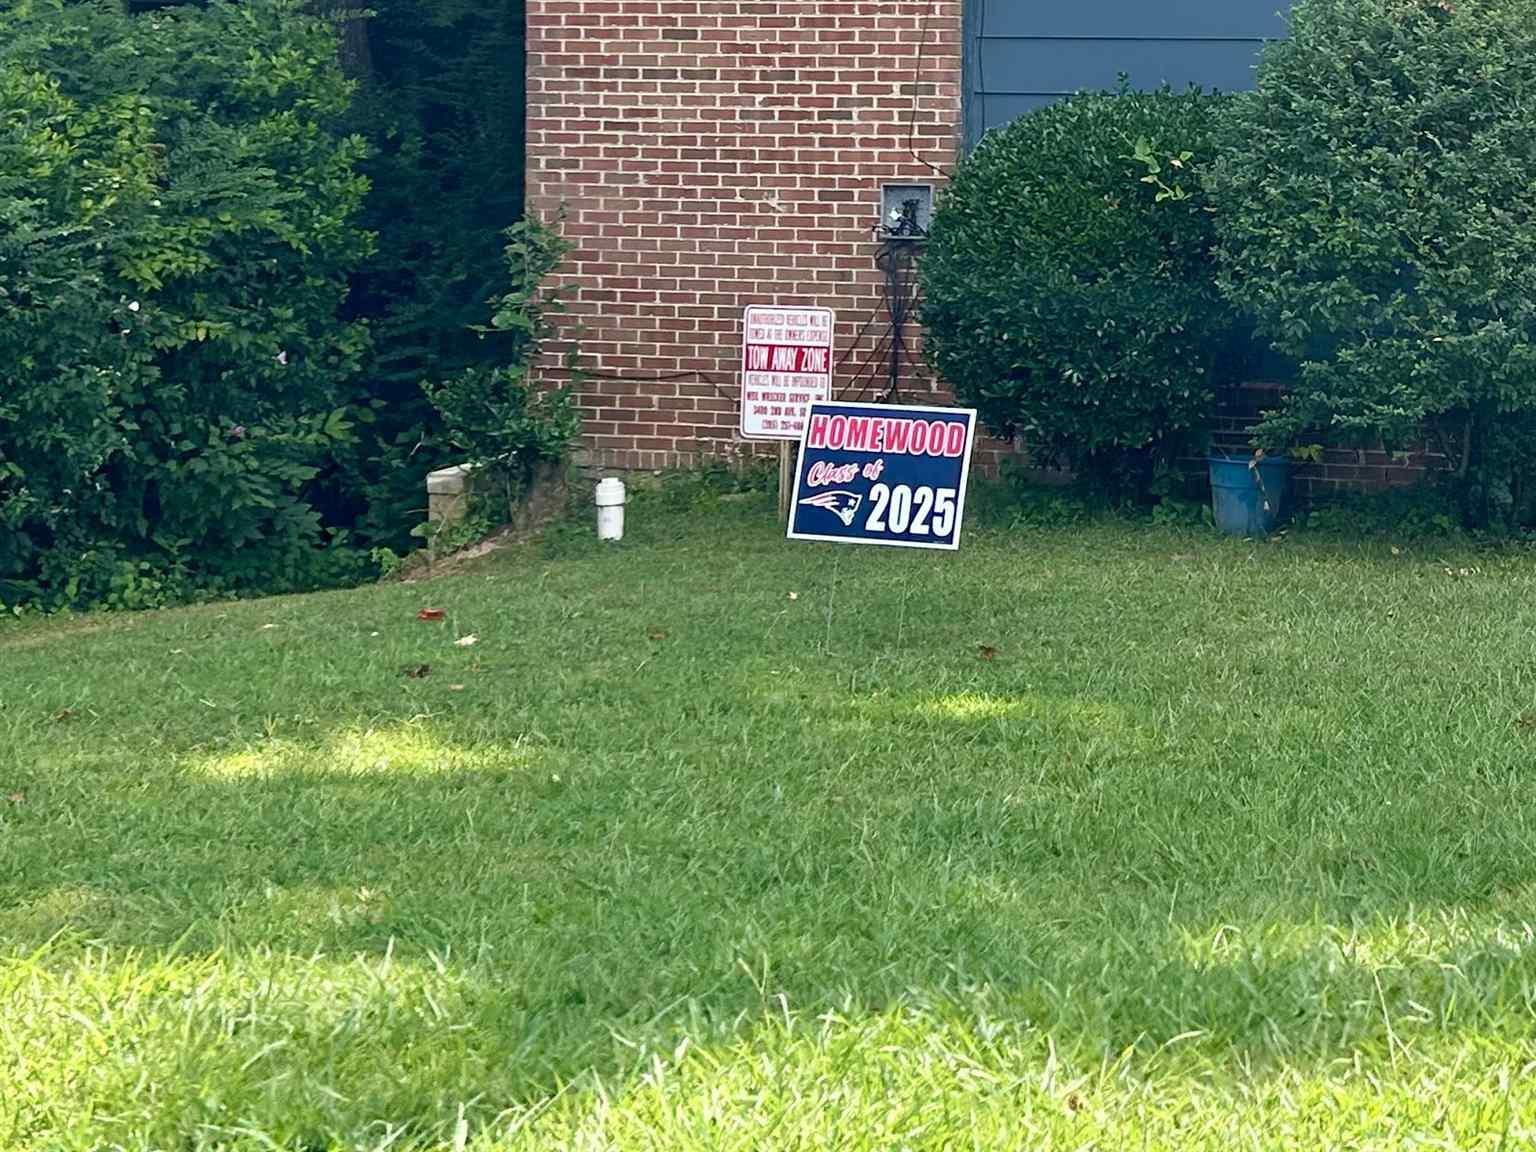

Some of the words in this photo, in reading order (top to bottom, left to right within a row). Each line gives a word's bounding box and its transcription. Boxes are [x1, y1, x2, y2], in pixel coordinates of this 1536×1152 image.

[747, 345, 769, 370] TOW
[771, 346, 799, 371] AWAY
[801, 347, 828, 372] ZONE
[807, 414, 966, 457] HOMEWOOD
[808, 460, 860, 487] Class
[863, 458, 884, 481] of
[865, 483, 956, 537] 2025
